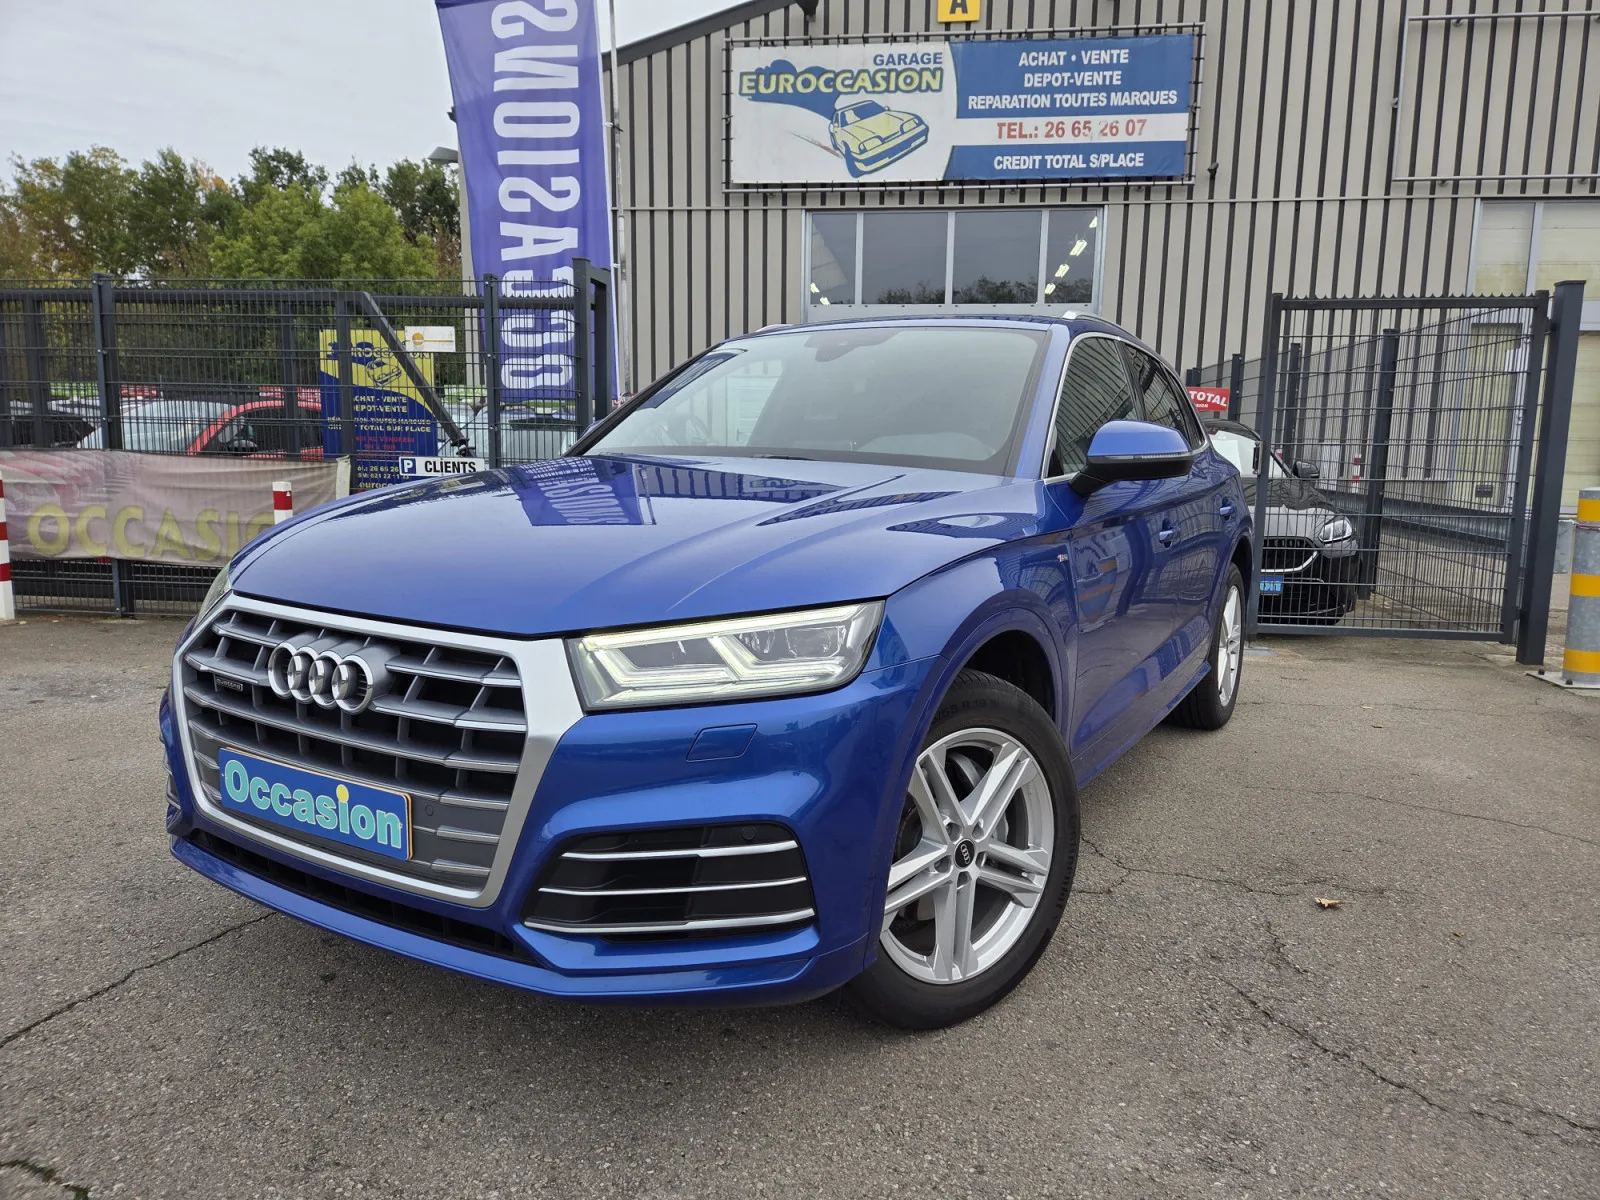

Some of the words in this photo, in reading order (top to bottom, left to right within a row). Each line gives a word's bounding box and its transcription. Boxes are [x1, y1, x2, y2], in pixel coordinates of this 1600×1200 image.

[949, 0, 969, 15] A
[872, 52, 943, 66] GARAGE
[1018, 51, 1067, 67] ACHAT
[1081, 49, 1129, 65] VENTE
[738, 67, 945, 97] EUROCCASION
[1023, 71, 1122, 88] DEPOT-VENTE
[967, 94, 1050, 110] REPARATION
[1053, 92, 1107, 108] TOUTES
[1109, 90, 1178, 107] MARQUES
[996, 122, 1039, 140] TEL.:
[1044, 120, 1065, 138] 26
[1071, 120, 1092, 137] 65
[1099, 119, 1119, 137] 26
[1125, 118, 1148, 136] 07
[993, 155, 1042, 170] CREDIT
[1044, 154, 1086, 169] TOTAL
[1089, 152, 1145, 169] S/PLACE
[1188, 390, 1228, 407] TOTAL
[403, 459, 413, 473] P
[424, 460, 477, 475] CLIENTS
[224, 758, 402, 849] Occasion
